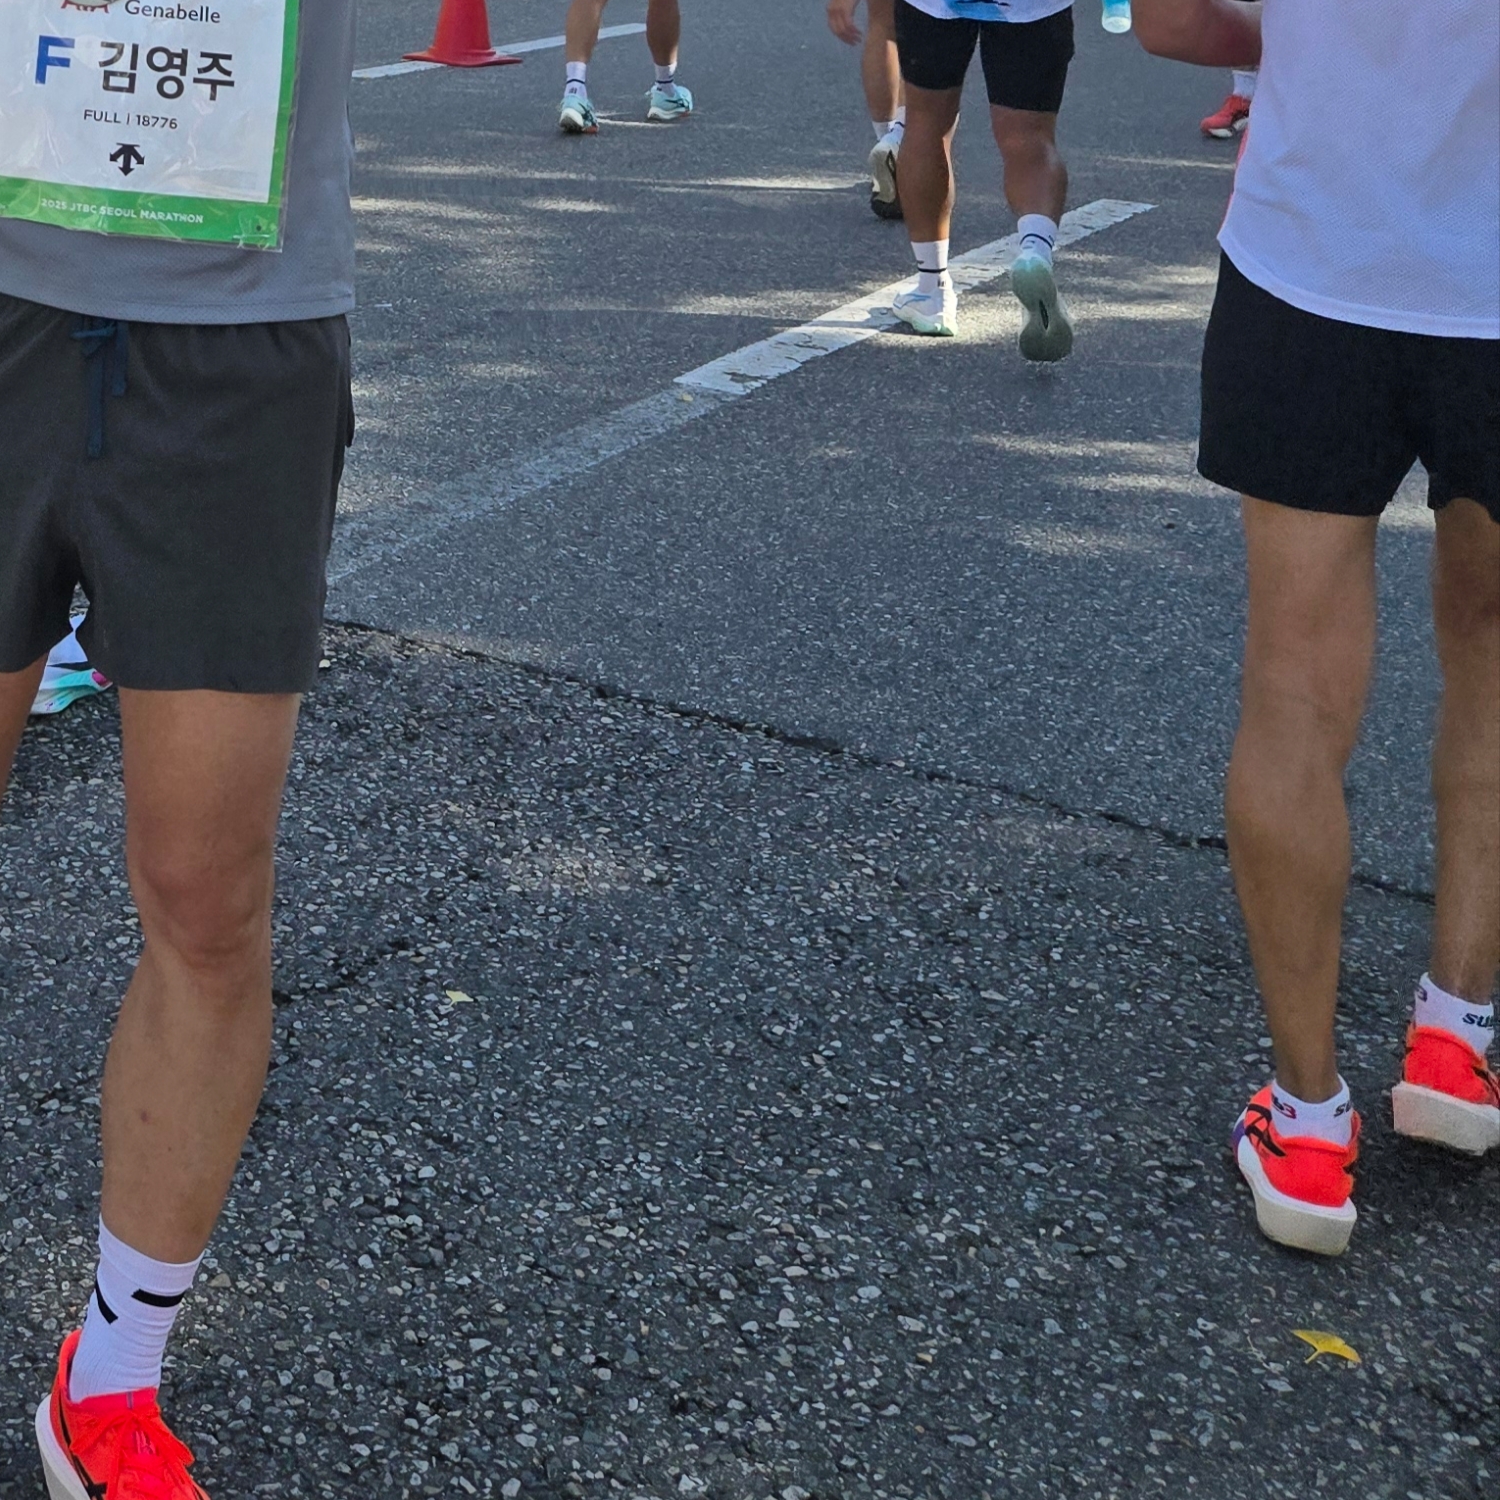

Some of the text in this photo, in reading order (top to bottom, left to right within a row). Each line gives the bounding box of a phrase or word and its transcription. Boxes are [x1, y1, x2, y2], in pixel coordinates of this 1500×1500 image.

[34, 34, 235, 101] F 김영주
[83, 109, 121, 125] FULL
[135, 113, 178, 130] 18776
[41, 198, 204, 224] 2025 JTBC SEOUL MARATHON
